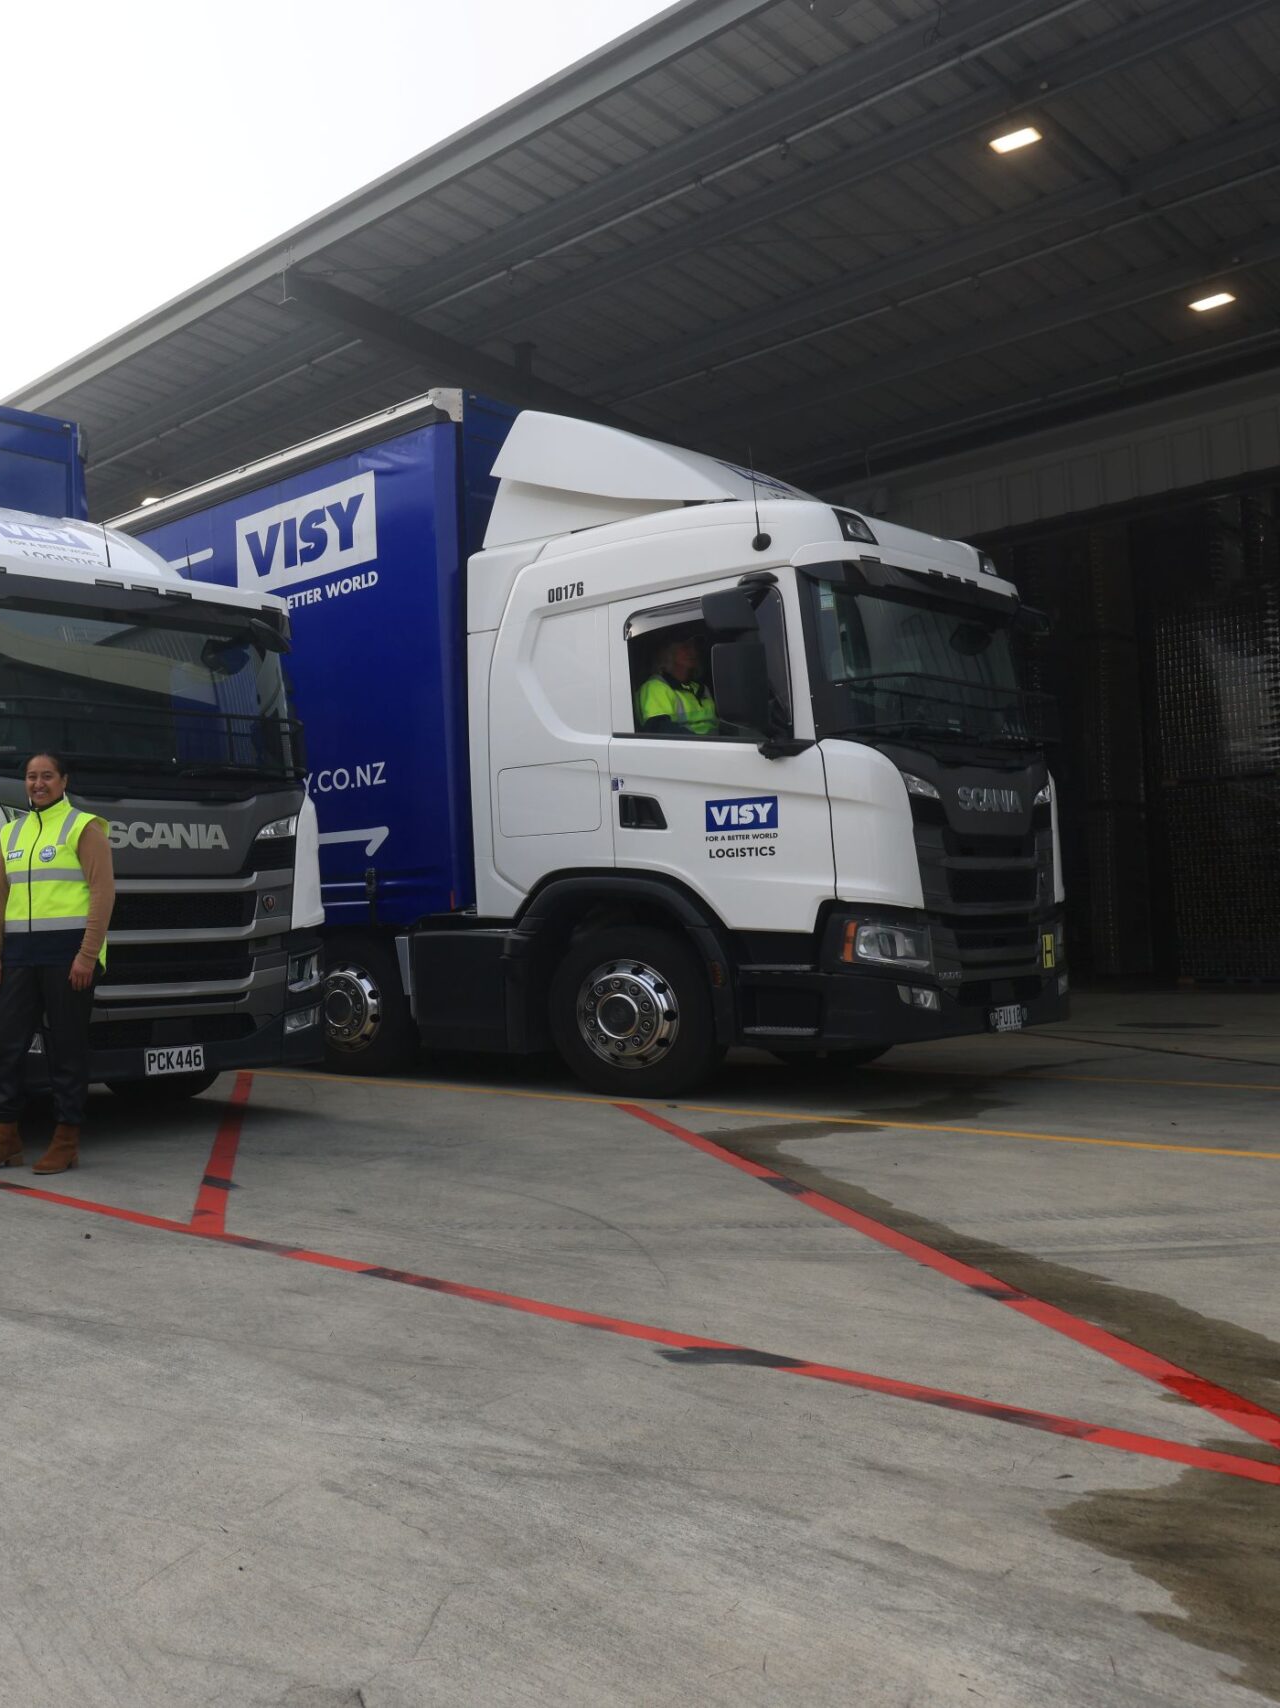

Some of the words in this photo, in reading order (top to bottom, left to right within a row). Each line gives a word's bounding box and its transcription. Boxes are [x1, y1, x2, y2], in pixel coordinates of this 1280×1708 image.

[245, 492, 365, 578] VISY
[22, 550, 109, 567] LOGISTICS
[287, 588, 322, 610] ETTER
[326, 571, 379, 599] WORLD
[548, 581, 584, 603] 00176
[302, 762, 387, 794] Y.CO.NZ
[957, 786, 1023, 813] SCANIA
[710, 803, 773, 825] VISY
[108, 820, 230, 850] SCANIA
[709, 846, 776, 858] LOGISTICS
[147, 1049, 202, 1072] PCK446
